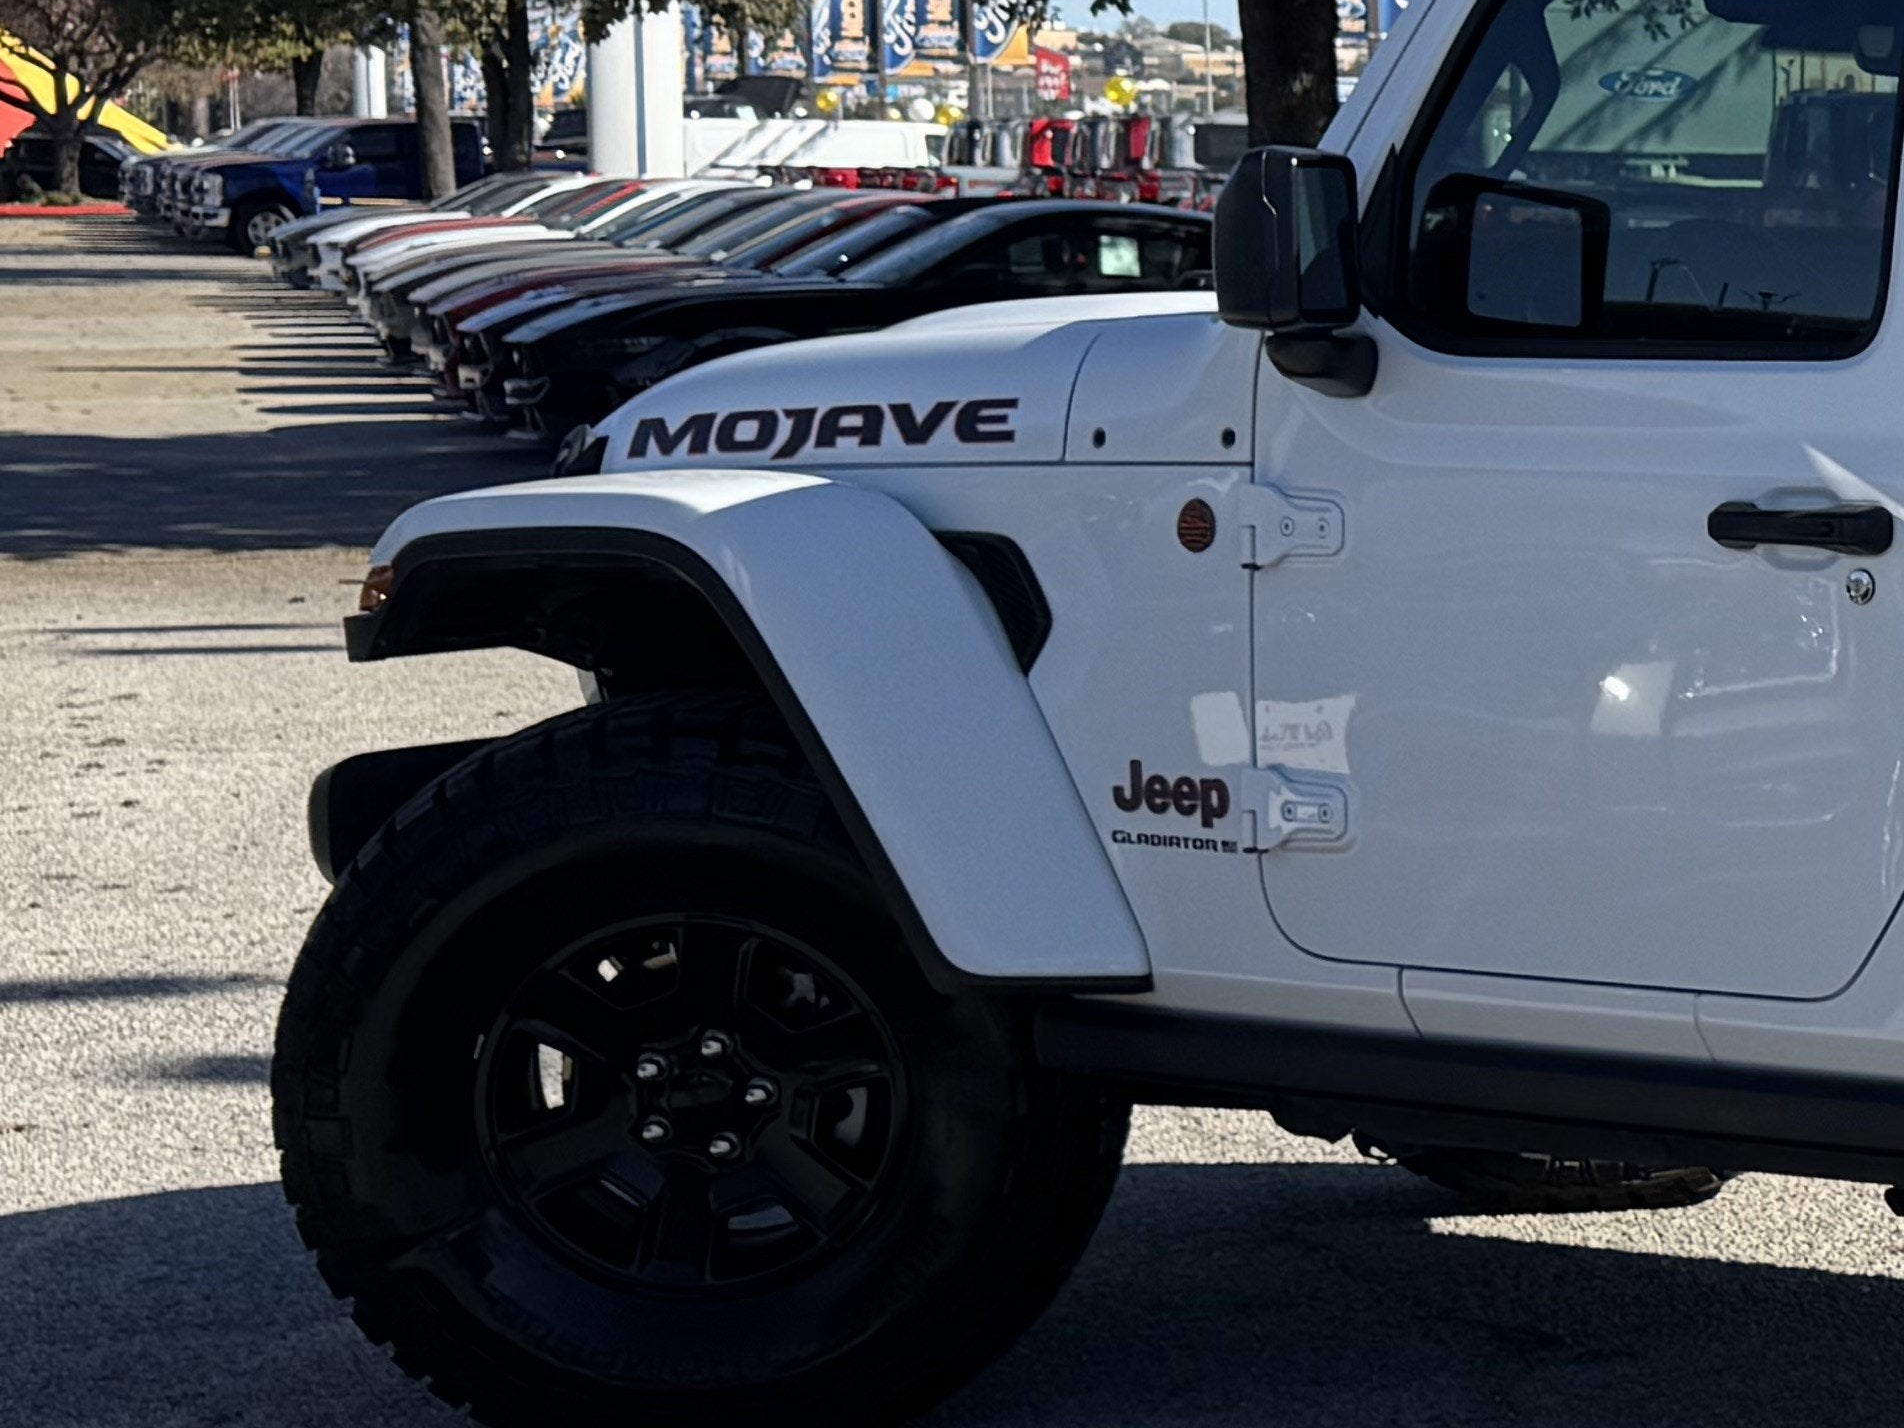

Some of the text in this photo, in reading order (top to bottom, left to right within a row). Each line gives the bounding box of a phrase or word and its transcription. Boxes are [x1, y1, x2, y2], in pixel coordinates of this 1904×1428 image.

[1615, 69, 1683, 99] Ford
[627, 398, 1019, 460] MOJAVE
[1112, 759, 1231, 829] Jeep
[1111, 829, 1218, 852] GLADIATOR
